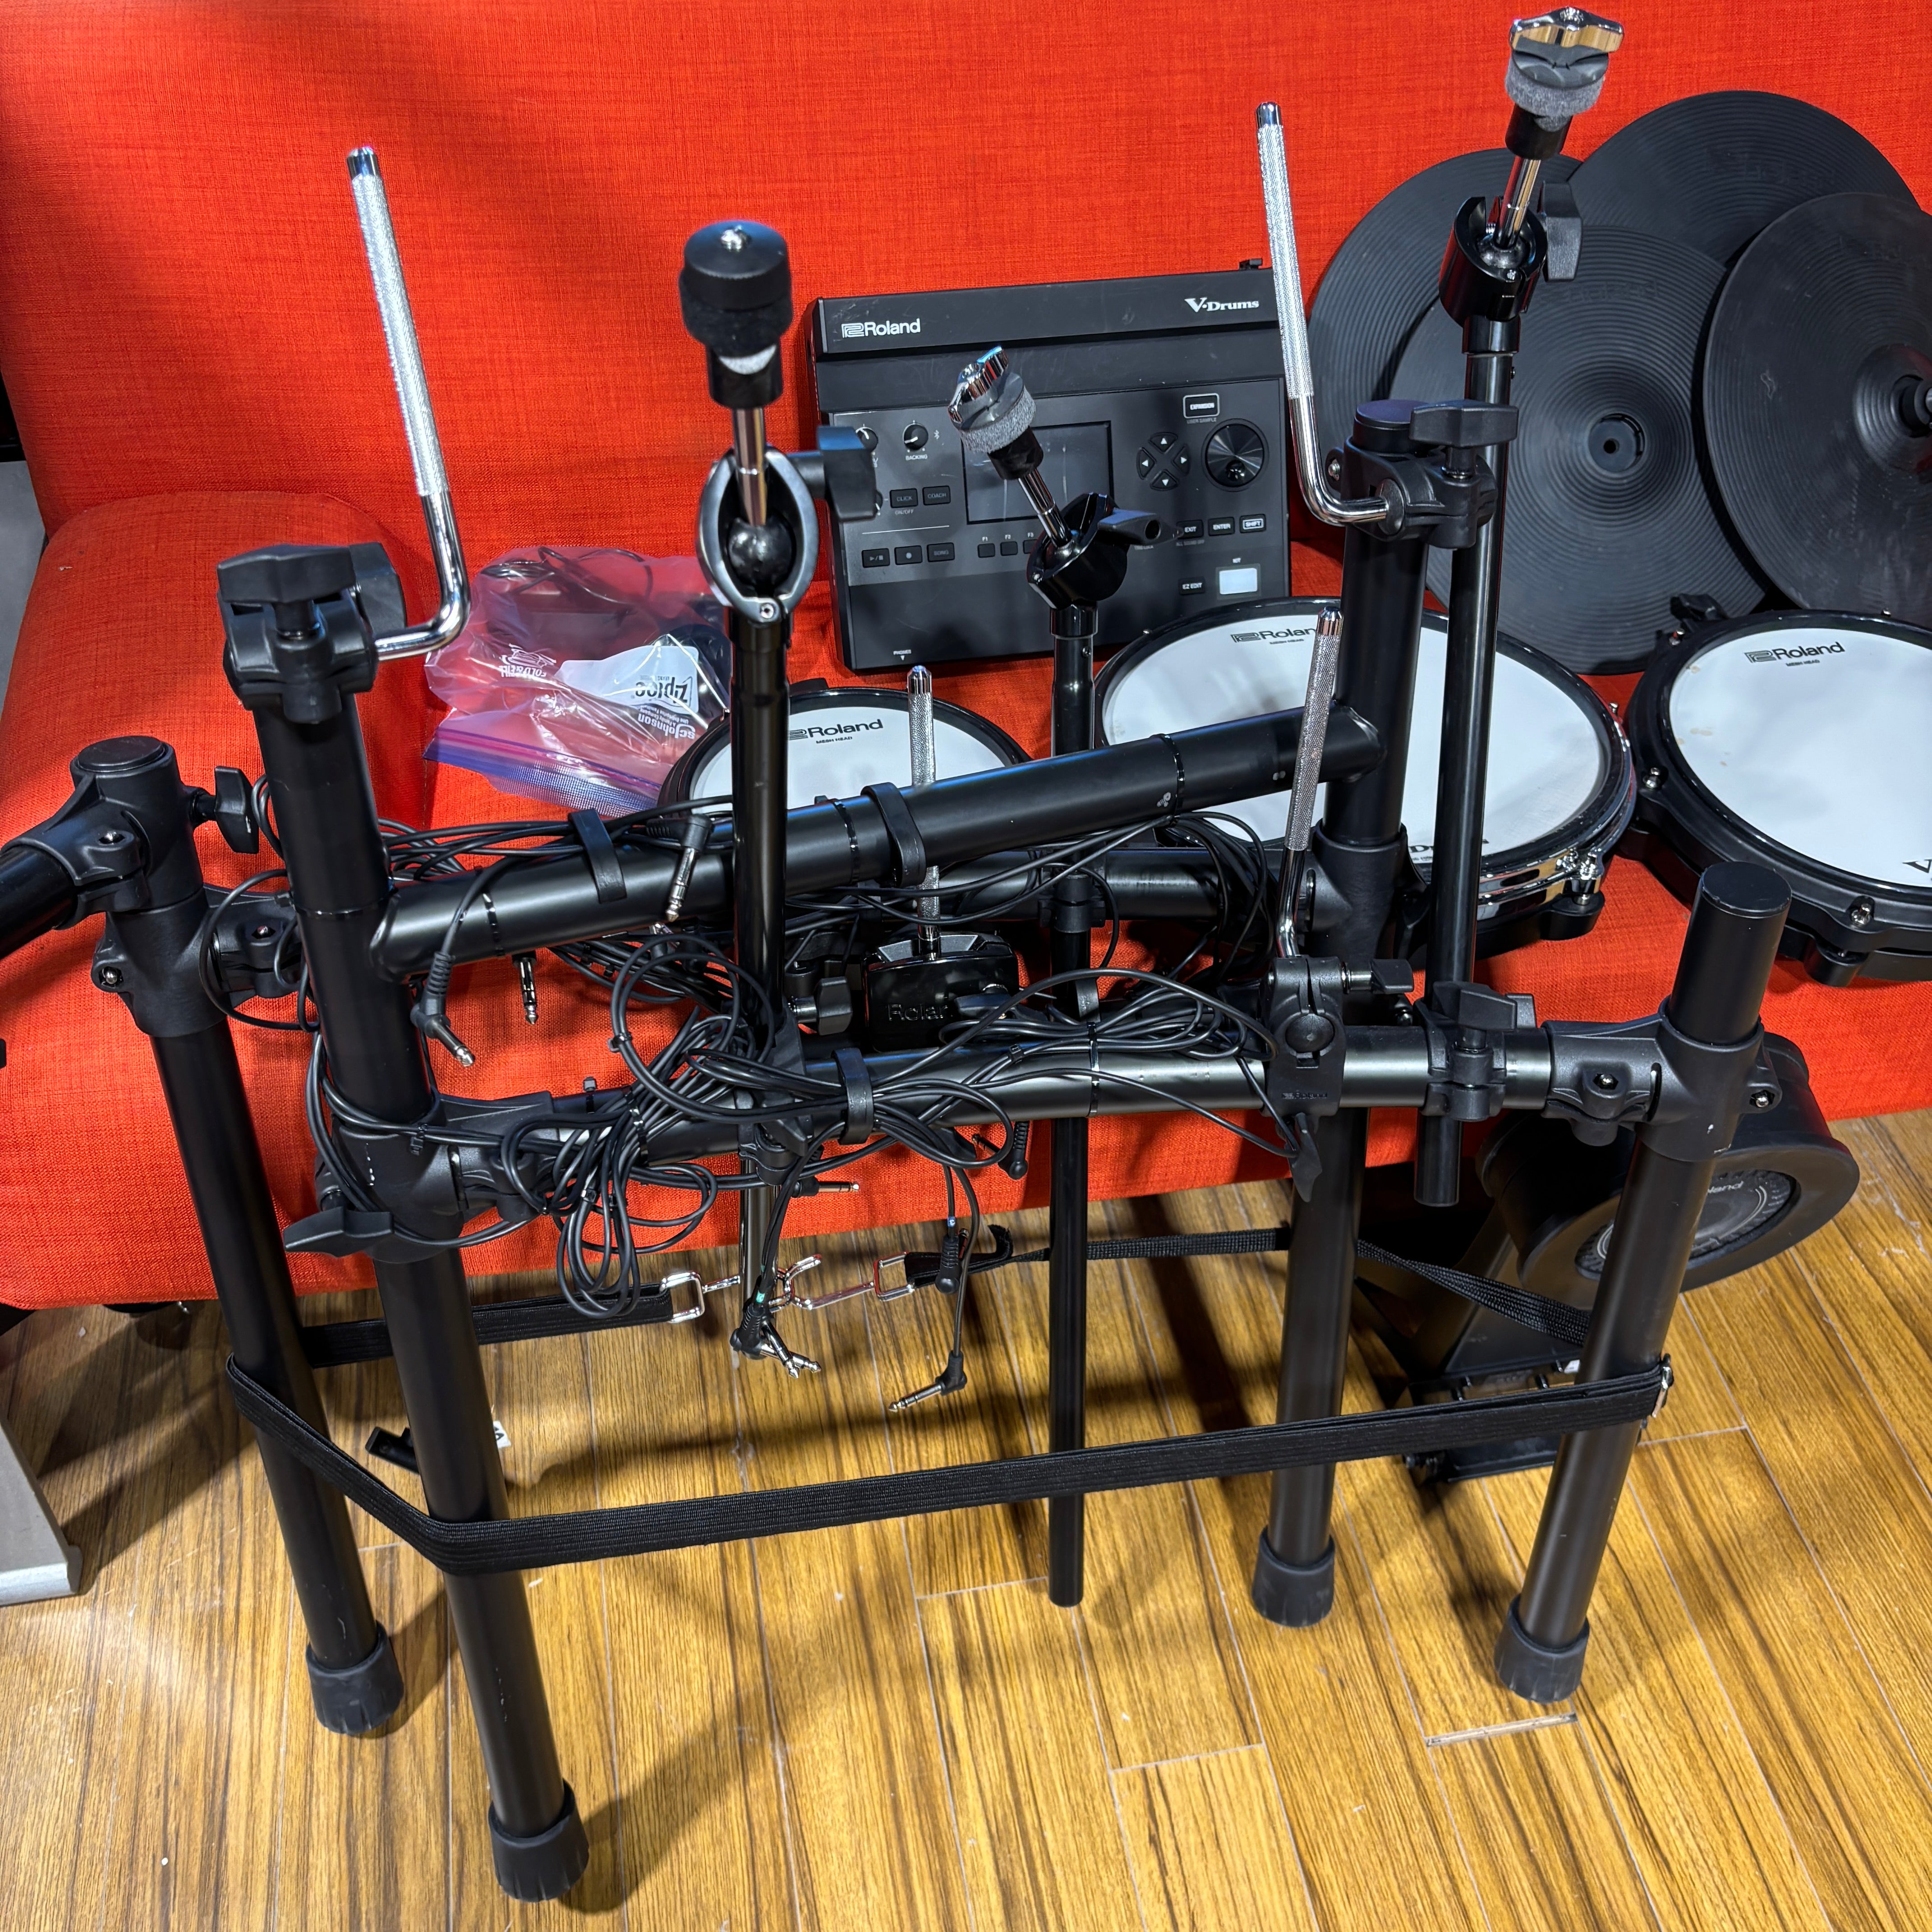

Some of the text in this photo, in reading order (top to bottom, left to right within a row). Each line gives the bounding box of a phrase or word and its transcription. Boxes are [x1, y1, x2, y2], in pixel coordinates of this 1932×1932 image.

[864, 317, 921, 337] Roland
[1259, 629, 1316, 639] Rolan
[1771, 641, 1845, 660] Roland
[635, 676, 688, 704] Ziploc
[808, 719, 883, 738] Roland
